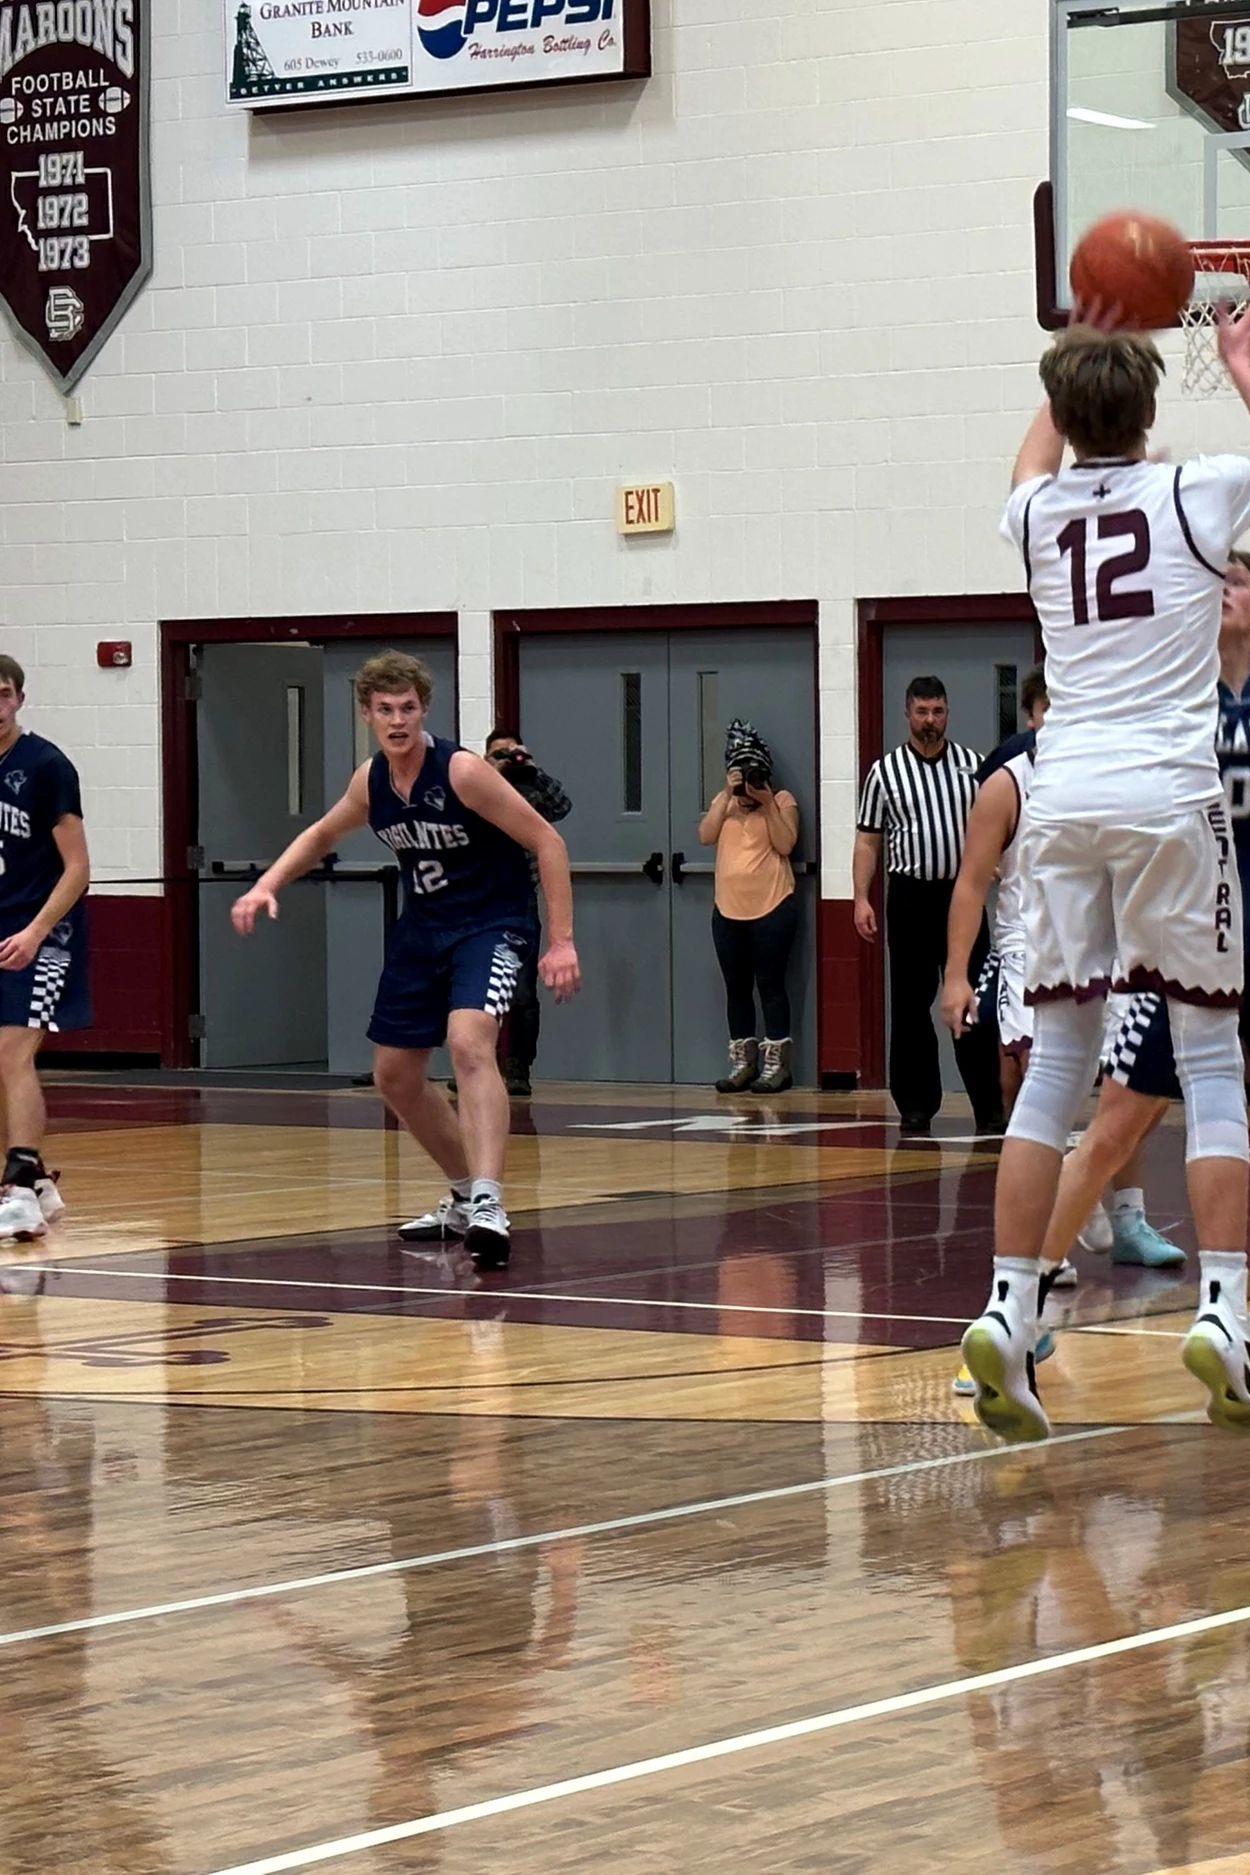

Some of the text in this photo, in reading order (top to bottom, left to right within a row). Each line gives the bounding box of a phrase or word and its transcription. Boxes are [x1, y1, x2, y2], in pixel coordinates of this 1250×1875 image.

[260, 3, 323, 20] GRANITE
[311, 21, 354, 39] BANK
[284, 59, 302, 71] 605
[305, 56, 341, 70] Dewey
[468, 42, 535, 62] Harrington
[543, 34, 591, 55] Bottling
[11, 68, 110, 96] FOOTBALL
[31, 94, 91, 118] STATE
[7, 116, 116, 144] CHAMPIONS
[38, 151, 86, 188] 1971
[37, 192, 89, 230] 1972
[38, 235, 91, 272] 1973
[624, 487, 661, 525] EXIT
[1056, 508, 1154, 626] 12
[413, 860, 449, 895] 12
[1208, 802, 1232, 953] ENTRAL
